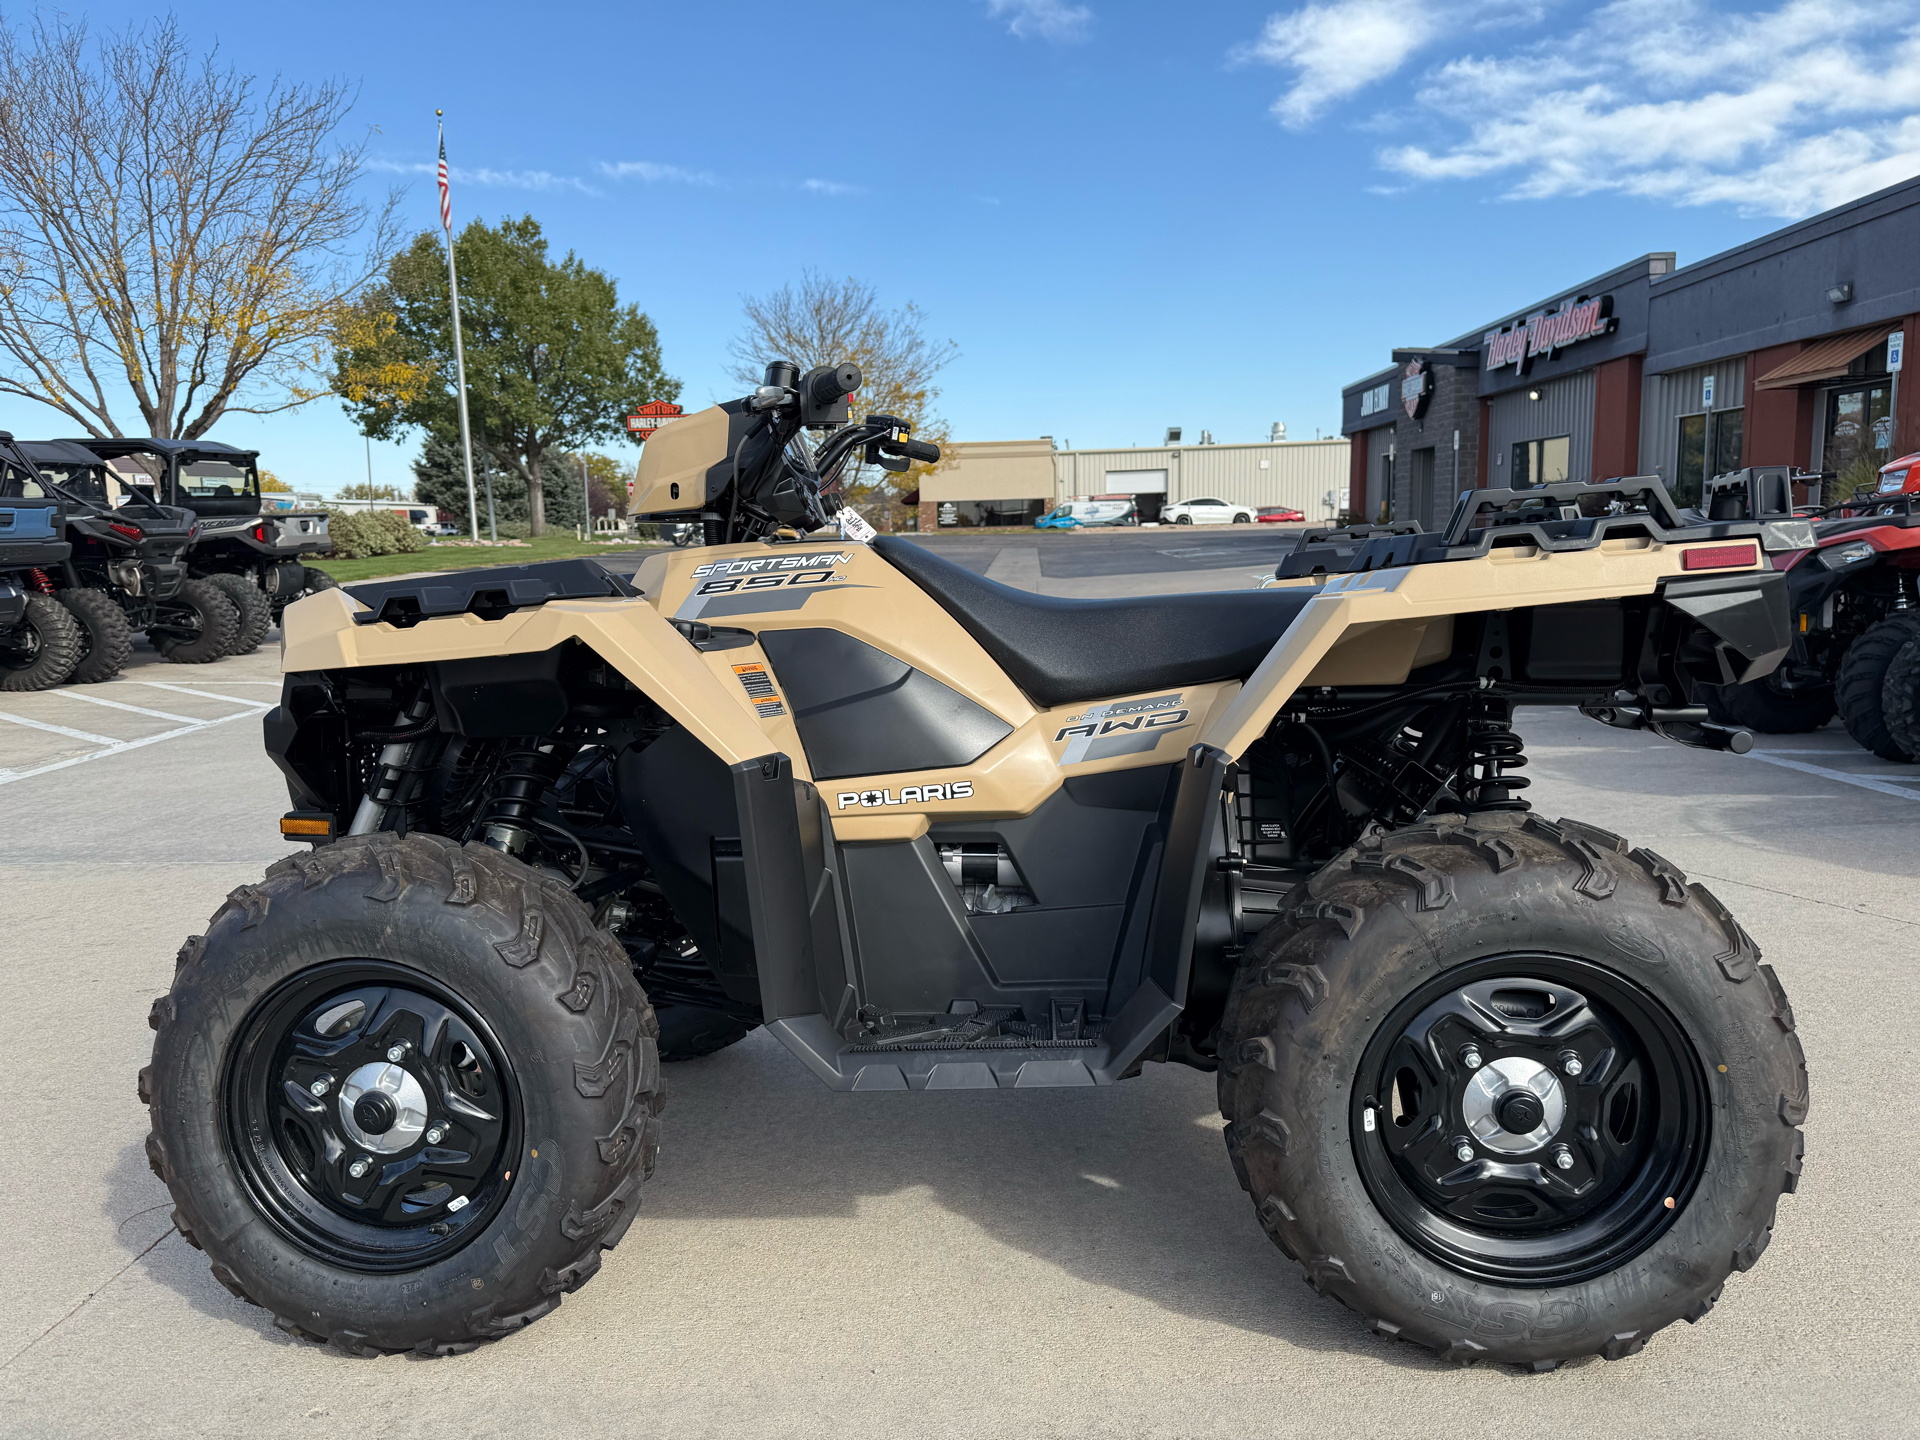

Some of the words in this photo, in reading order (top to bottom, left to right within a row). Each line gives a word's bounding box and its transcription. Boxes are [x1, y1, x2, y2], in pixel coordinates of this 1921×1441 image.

[1484, 297, 1608, 376] Harley-Davidson
[643, 403, 675, 414] MOTOR
[690, 553, 854, 578] SPORTSMAN
[694, 570, 836, 596] 850
[1066, 713, 1094, 722] ON
[1101, 699, 1184, 717] DEMAND
[1053, 709, 1190, 743] AWD
[837, 780, 975, 811] POLARIS
[1361, 973, 1389, 1002] NYLON
[496, 1139, 564, 1280] CST
[1423, 1294, 1588, 1341] CST
